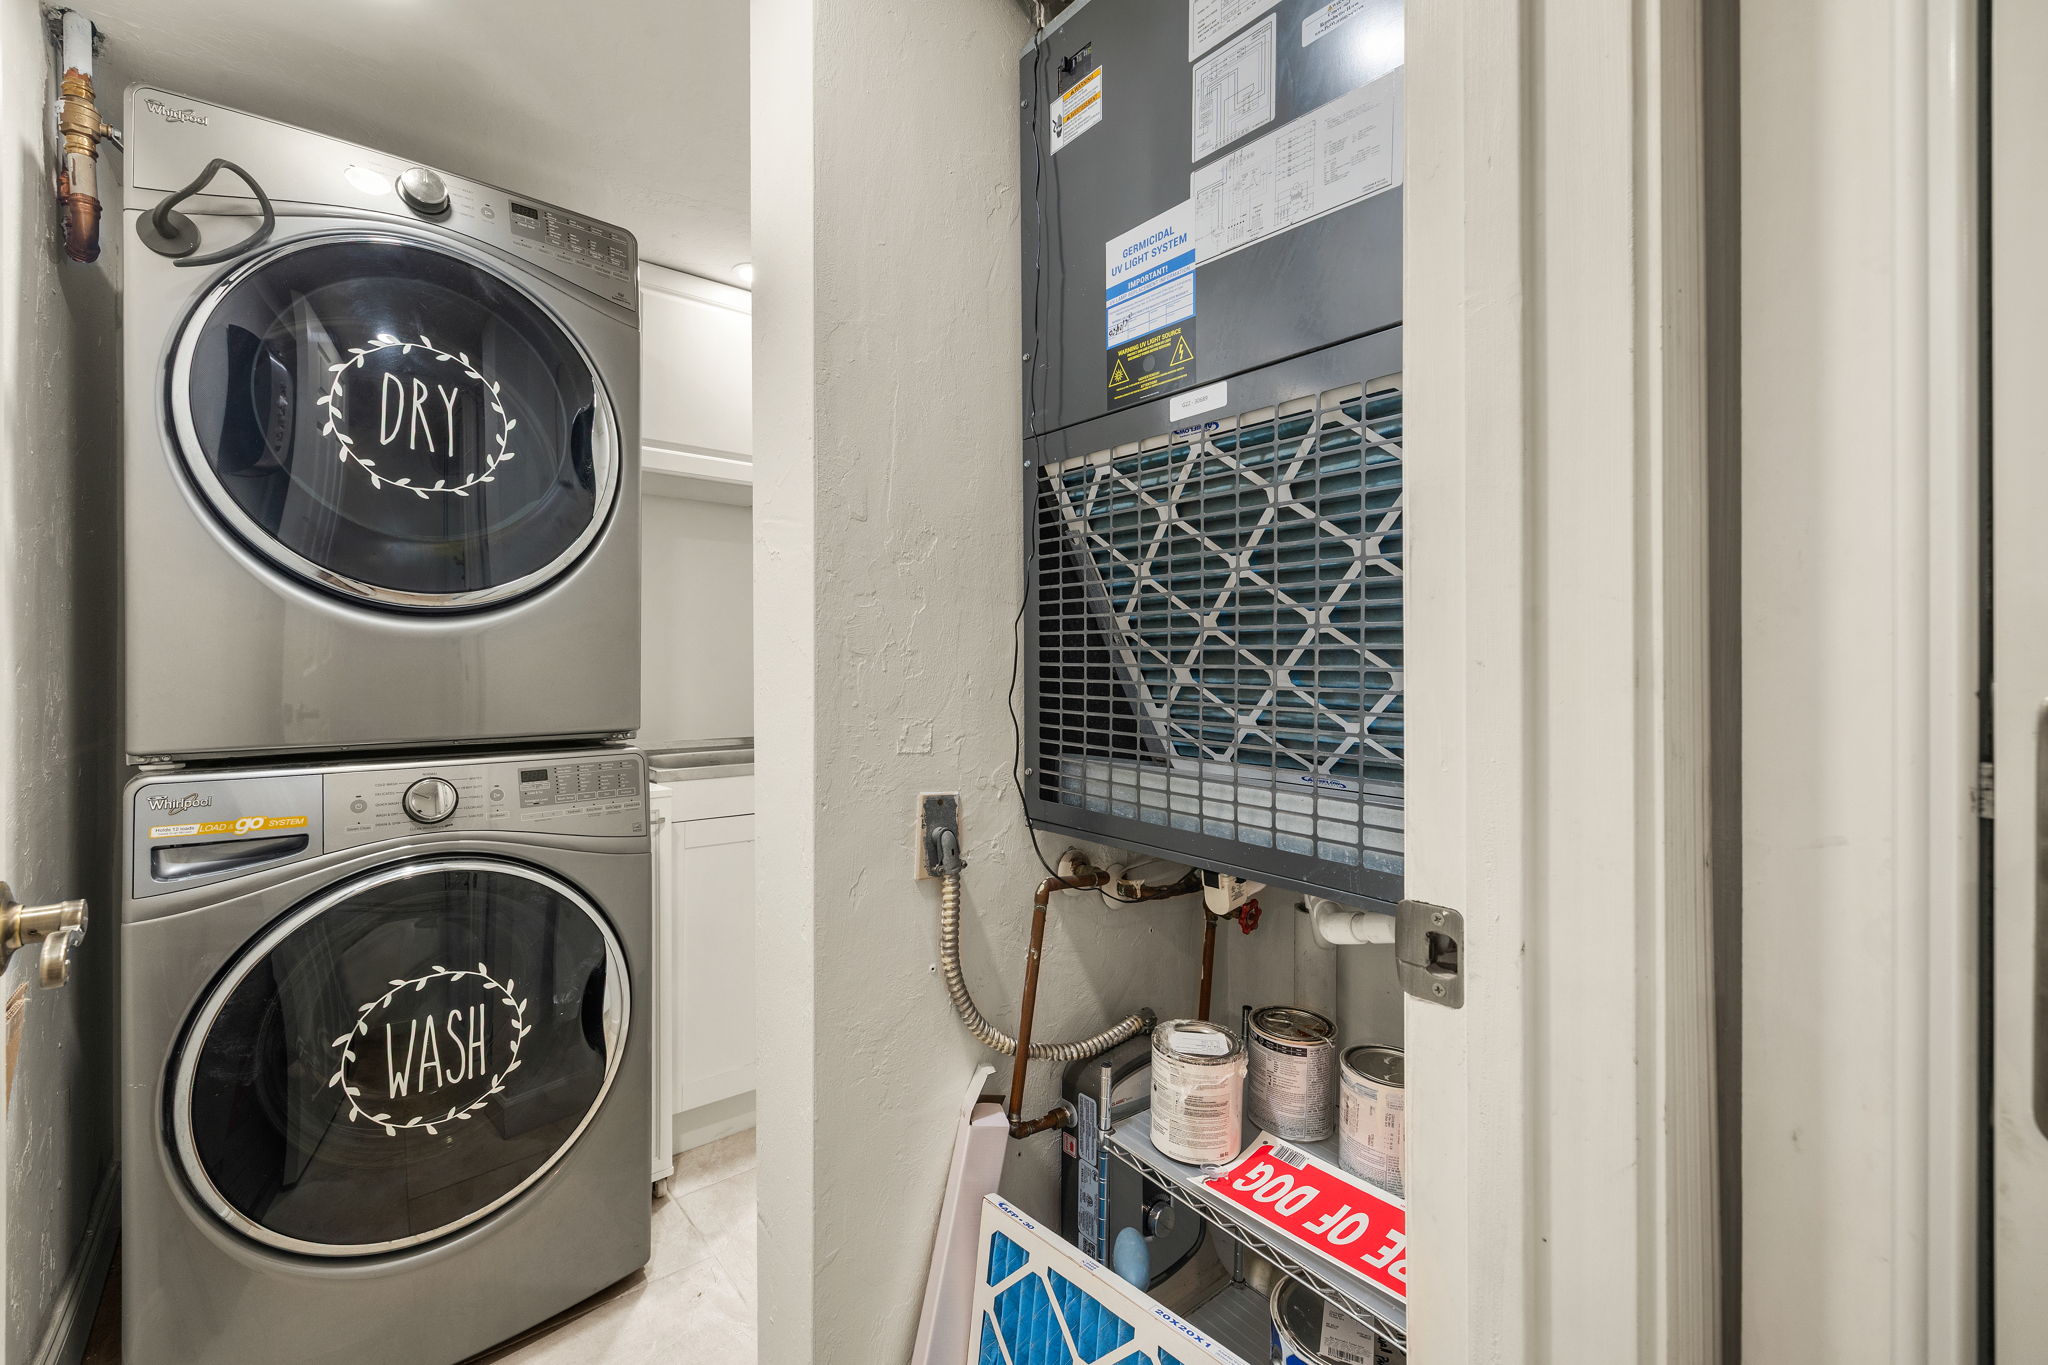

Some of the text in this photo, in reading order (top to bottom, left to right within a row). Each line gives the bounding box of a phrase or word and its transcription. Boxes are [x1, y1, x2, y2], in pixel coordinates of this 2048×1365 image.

[144, 99, 208, 127] Whirlpool
[1111, 232, 1188, 277] UV LIGHT SYSTEM
[1122, 226, 1175, 259] GERMICIDAL
[1127, 265, 1169, 290] IMPORTANT!
[1139, 340, 1147, 349] UV
[1147, 335, 1162, 347] LIGHT
[1161, 327, 1182, 340] SOURCE
[380, 372, 459, 458] DRY
[148, 793, 212, 814] Whirlpool
[199, 823, 226, 833] LOAD
[234, 817, 264, 835] go
[268, 817, 305, 828] SYSTEM
[386, 1003, 486, 1099] WASH
[1232, 1161, 1321, 1217] DOG
[1022, 1221, 1036, 1231] 30
[1302, 1204, 1370, 1245] OF
[1154, 1308, 1212, 1349] 20X20X1
